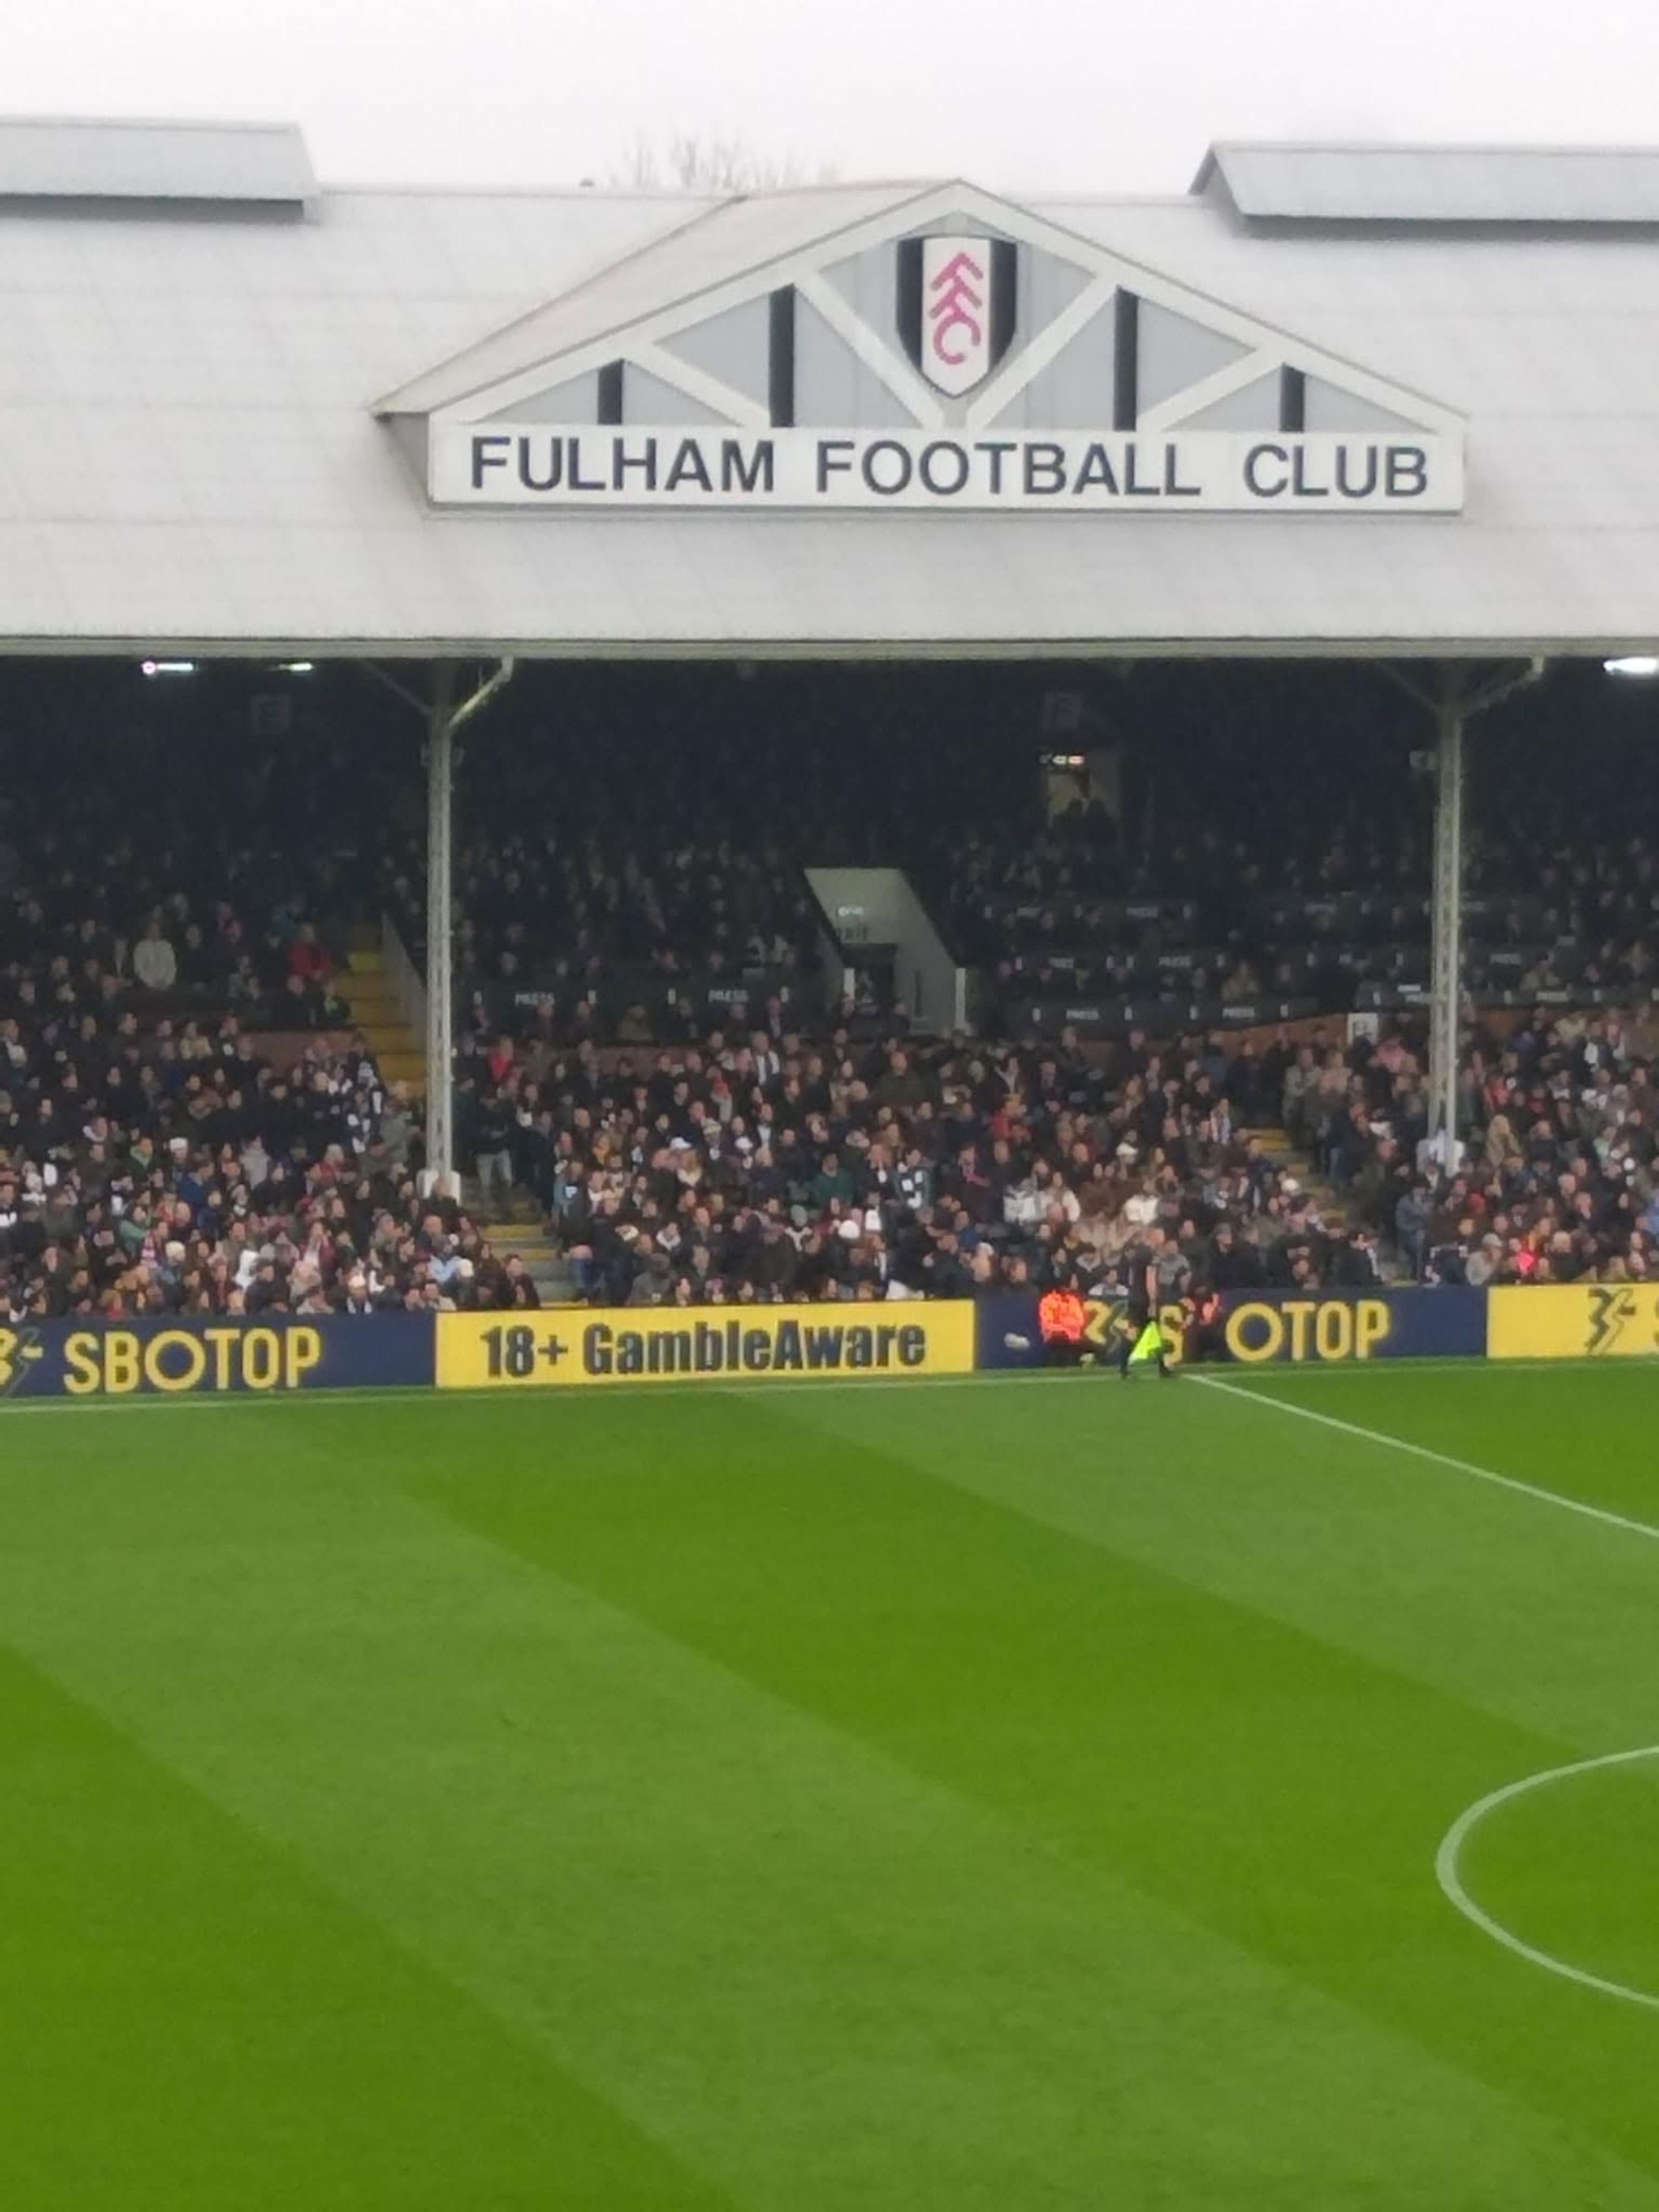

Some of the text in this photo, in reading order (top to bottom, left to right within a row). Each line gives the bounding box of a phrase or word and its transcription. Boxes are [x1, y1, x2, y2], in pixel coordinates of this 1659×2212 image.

[471, 436, 1428, 498] FULHAM FOOTBALL CLUB
[64, 1325, 322, 1394] SBOTOP
[480, 1319, 926, 1378] 18+ GambleAware
[1160, 1300, 1391, 1370] SOTOP
